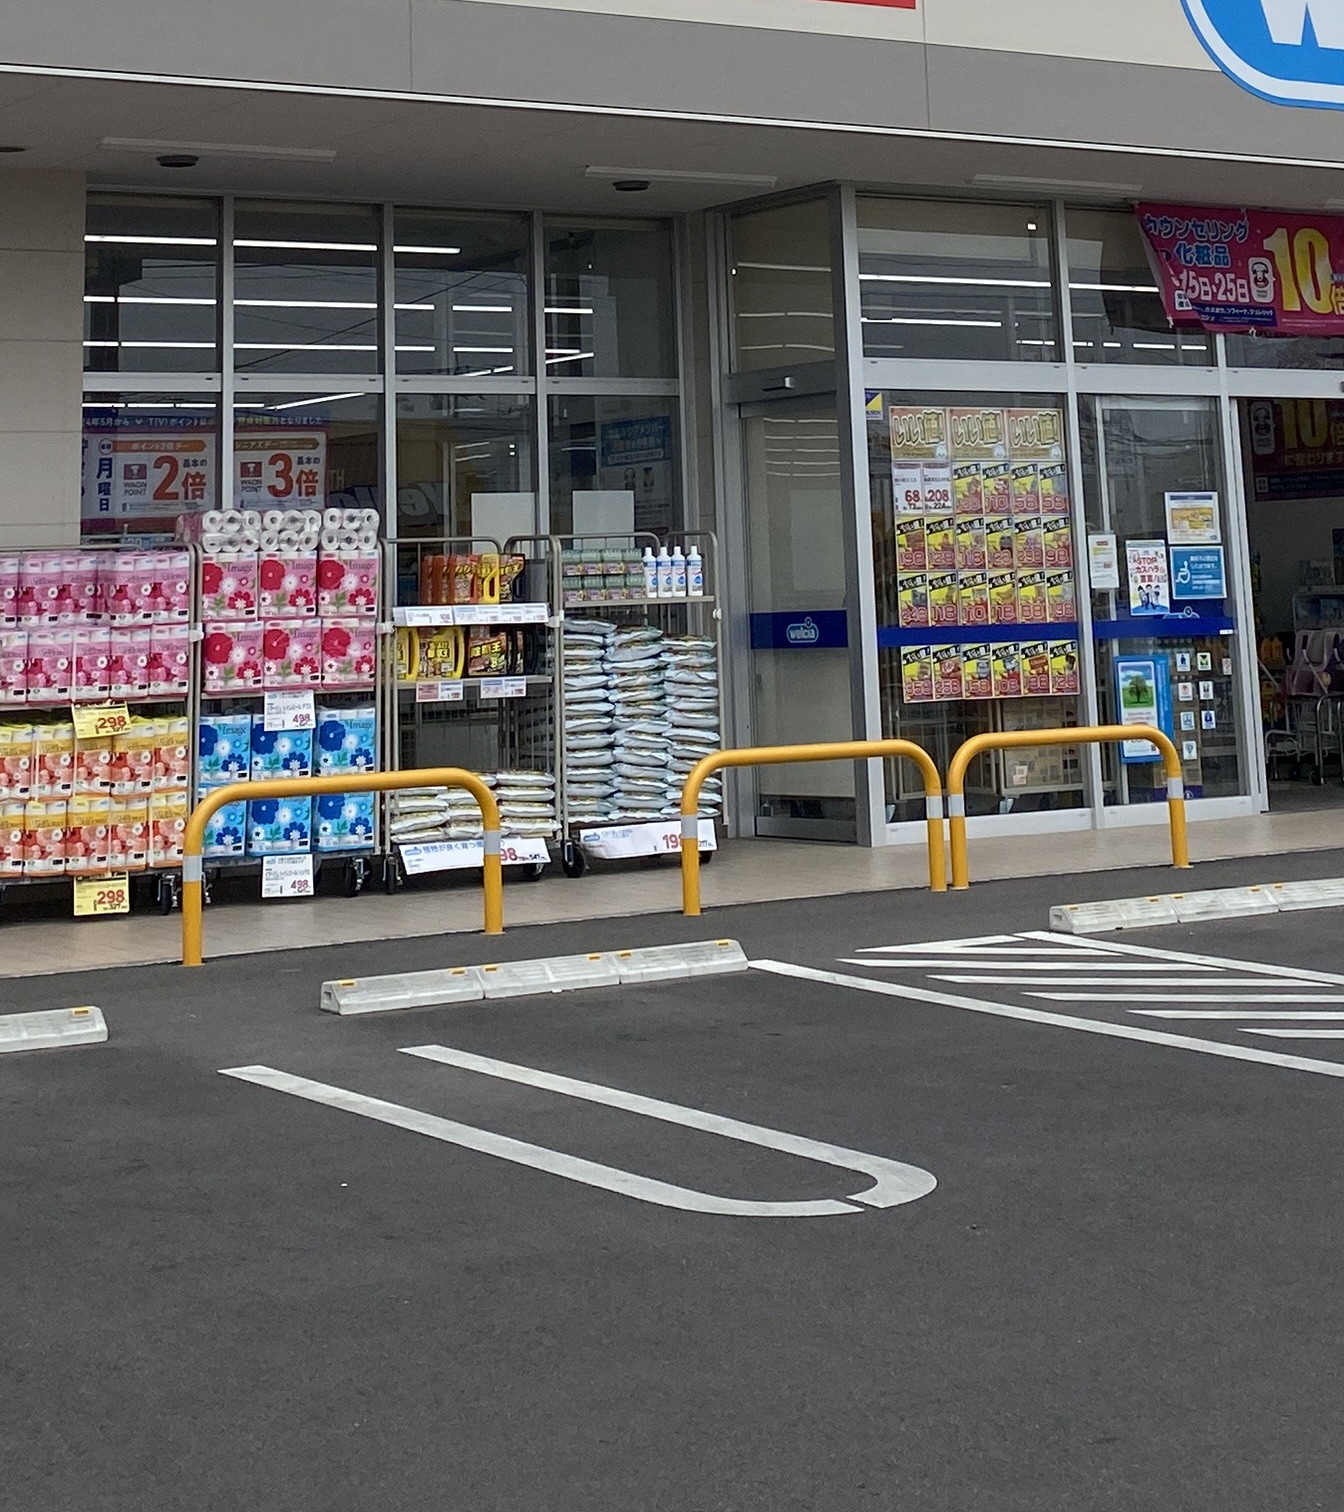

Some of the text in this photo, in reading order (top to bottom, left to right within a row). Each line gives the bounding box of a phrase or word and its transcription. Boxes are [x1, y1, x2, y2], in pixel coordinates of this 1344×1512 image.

[1173, 241, 1231, 268] 化粧品
[97, 716, 127, 728] 298
[97, 889, 125, 905] 298
